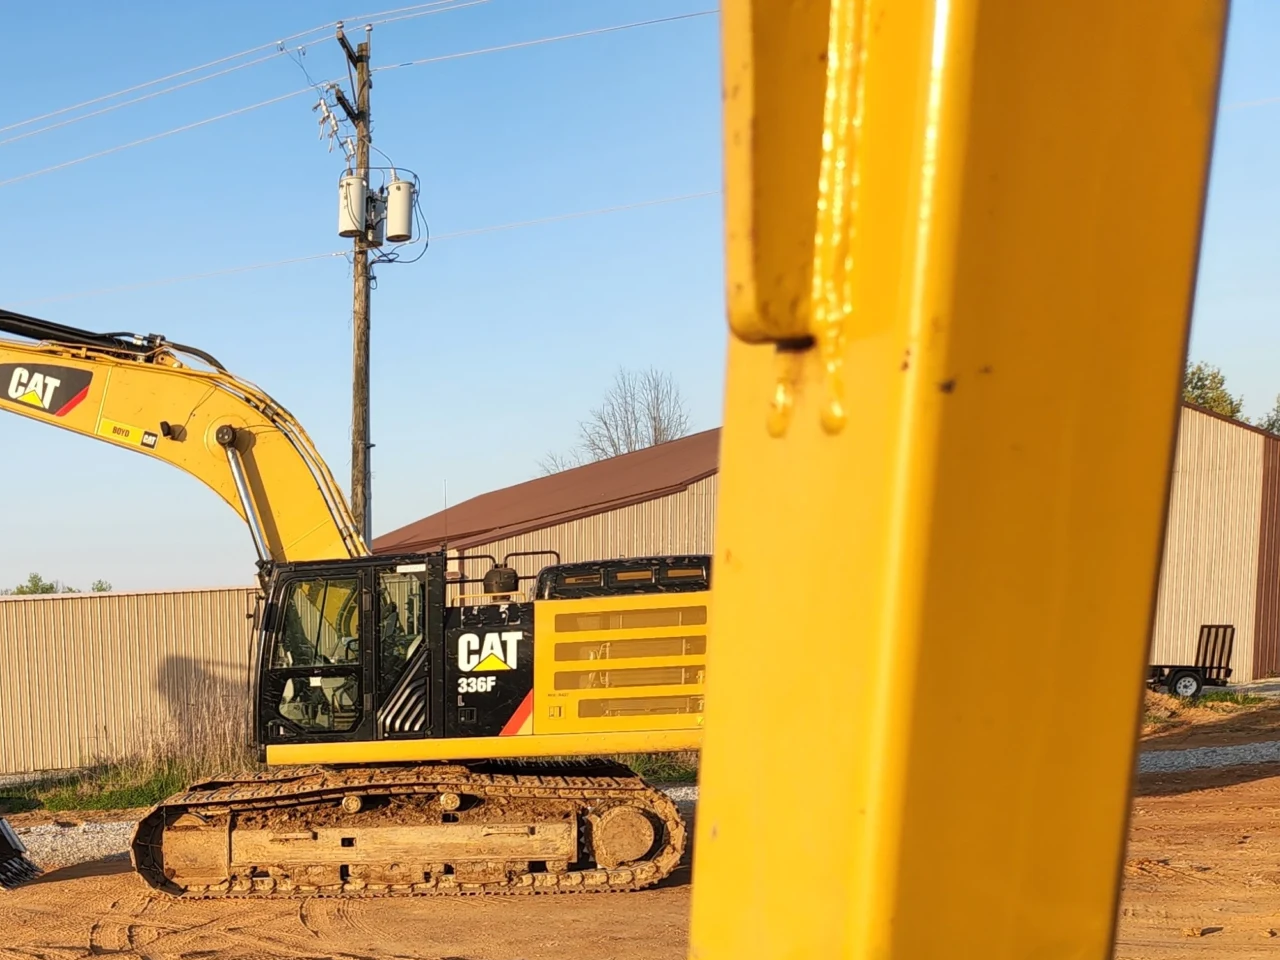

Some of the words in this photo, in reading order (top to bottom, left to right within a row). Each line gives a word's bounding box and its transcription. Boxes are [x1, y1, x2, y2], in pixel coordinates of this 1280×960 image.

[8, 367, 61, 410] CAT
[112, 426, 130, 438] BOYD
[142, 434, 156, 446] CAT
[457, 631, 523, 672] CAT
[457, 676, 497, 693] 336F
[457, 695, 465, 706] L
